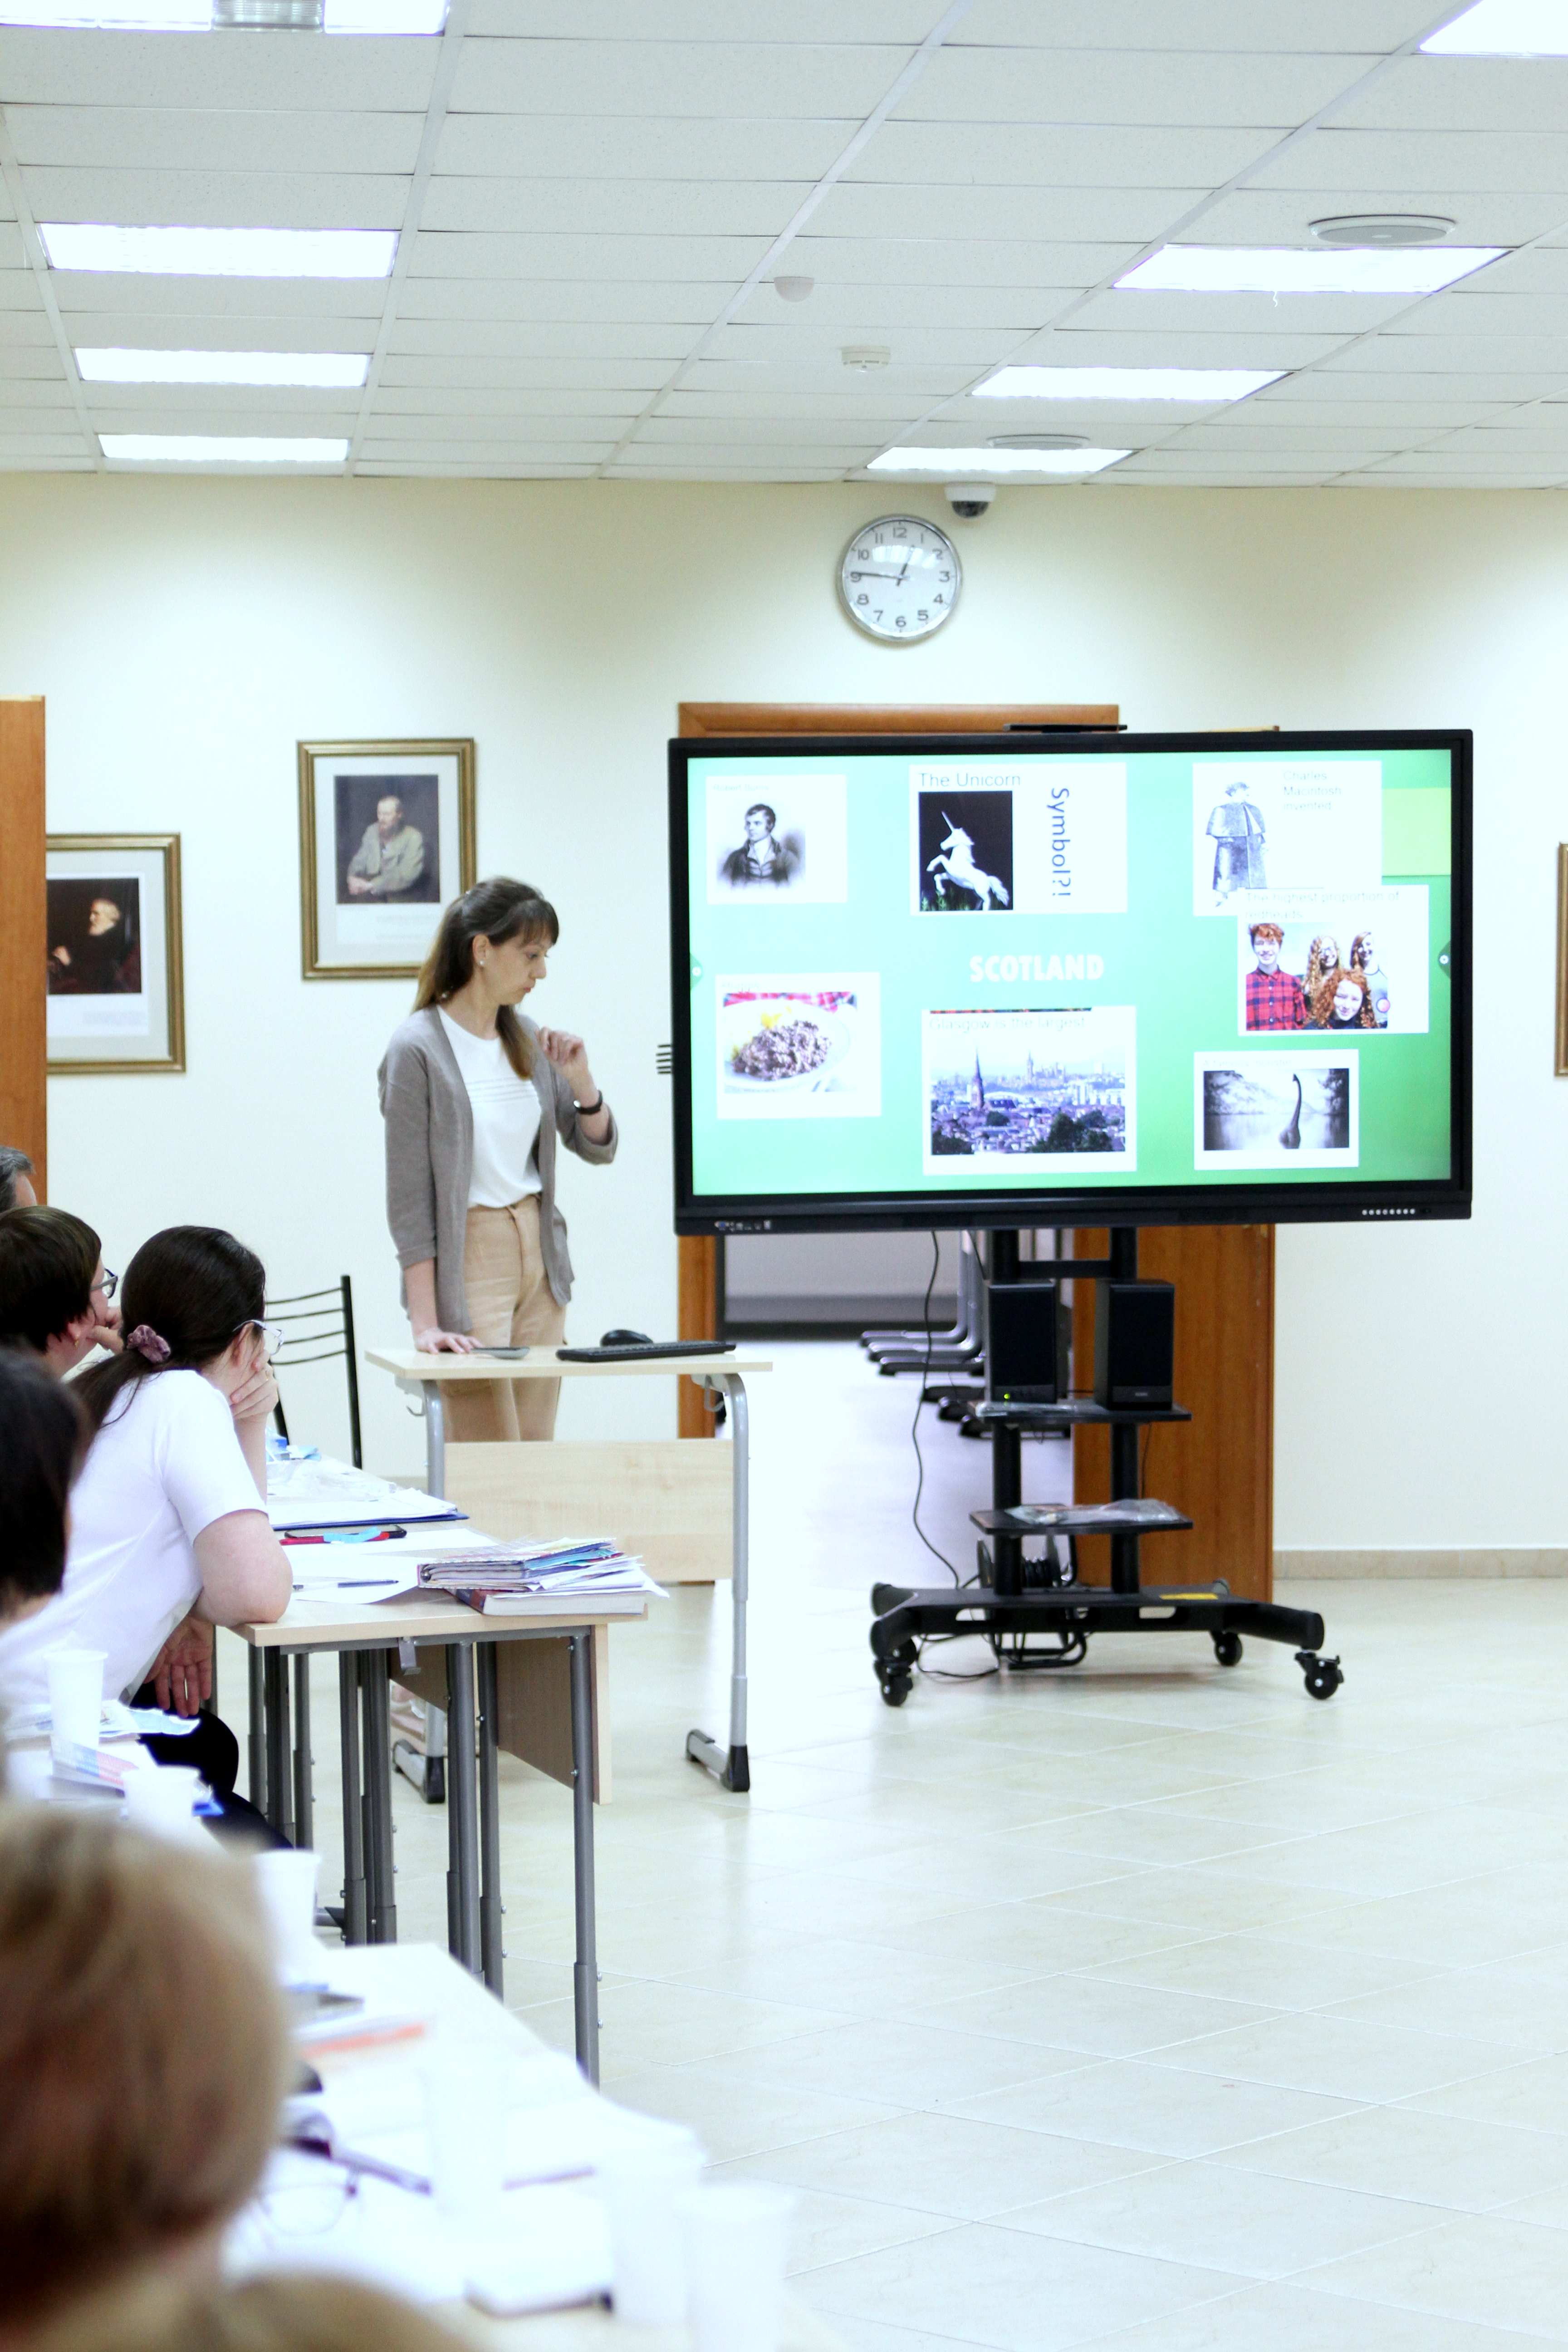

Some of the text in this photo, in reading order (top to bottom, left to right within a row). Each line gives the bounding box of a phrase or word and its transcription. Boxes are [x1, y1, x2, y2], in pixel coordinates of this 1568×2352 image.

[893, 527, 907, 538] 12
[875, 533, 883, 544] 11
[920, 533, 924, 544] 1
[858, 549, 870, 560] 10
[932, 548, 943, 560] 2
[850, 571, 862, 583] 9
[939, 570, 950, 583] 3
[857, 594, 869, 605] 8
[933, 593, 944, 604] 4
[873, 610, 884, 622] 7
[917, 610, 929, 621] 5
[895, 616, 906, 627] 6
[918, 772, 1021, 787] The Unicorn
[1283, 770, 1328, 781] Charles
[713, 784, 742, 792] Robert
[1283, 785, 1342, 796] Macintosh
[1283, 800, 1332, 811] invented
[1046, 787, 1071, 897] Symbol?!
[1246, 890, 1400, 906] The highest proportion of
[1245, 909, 1303, 920] redheads
[970, 954, 1104, 982] SCOTLAND
[929, 1017, 1085, 1034] Glasgow is the largest
